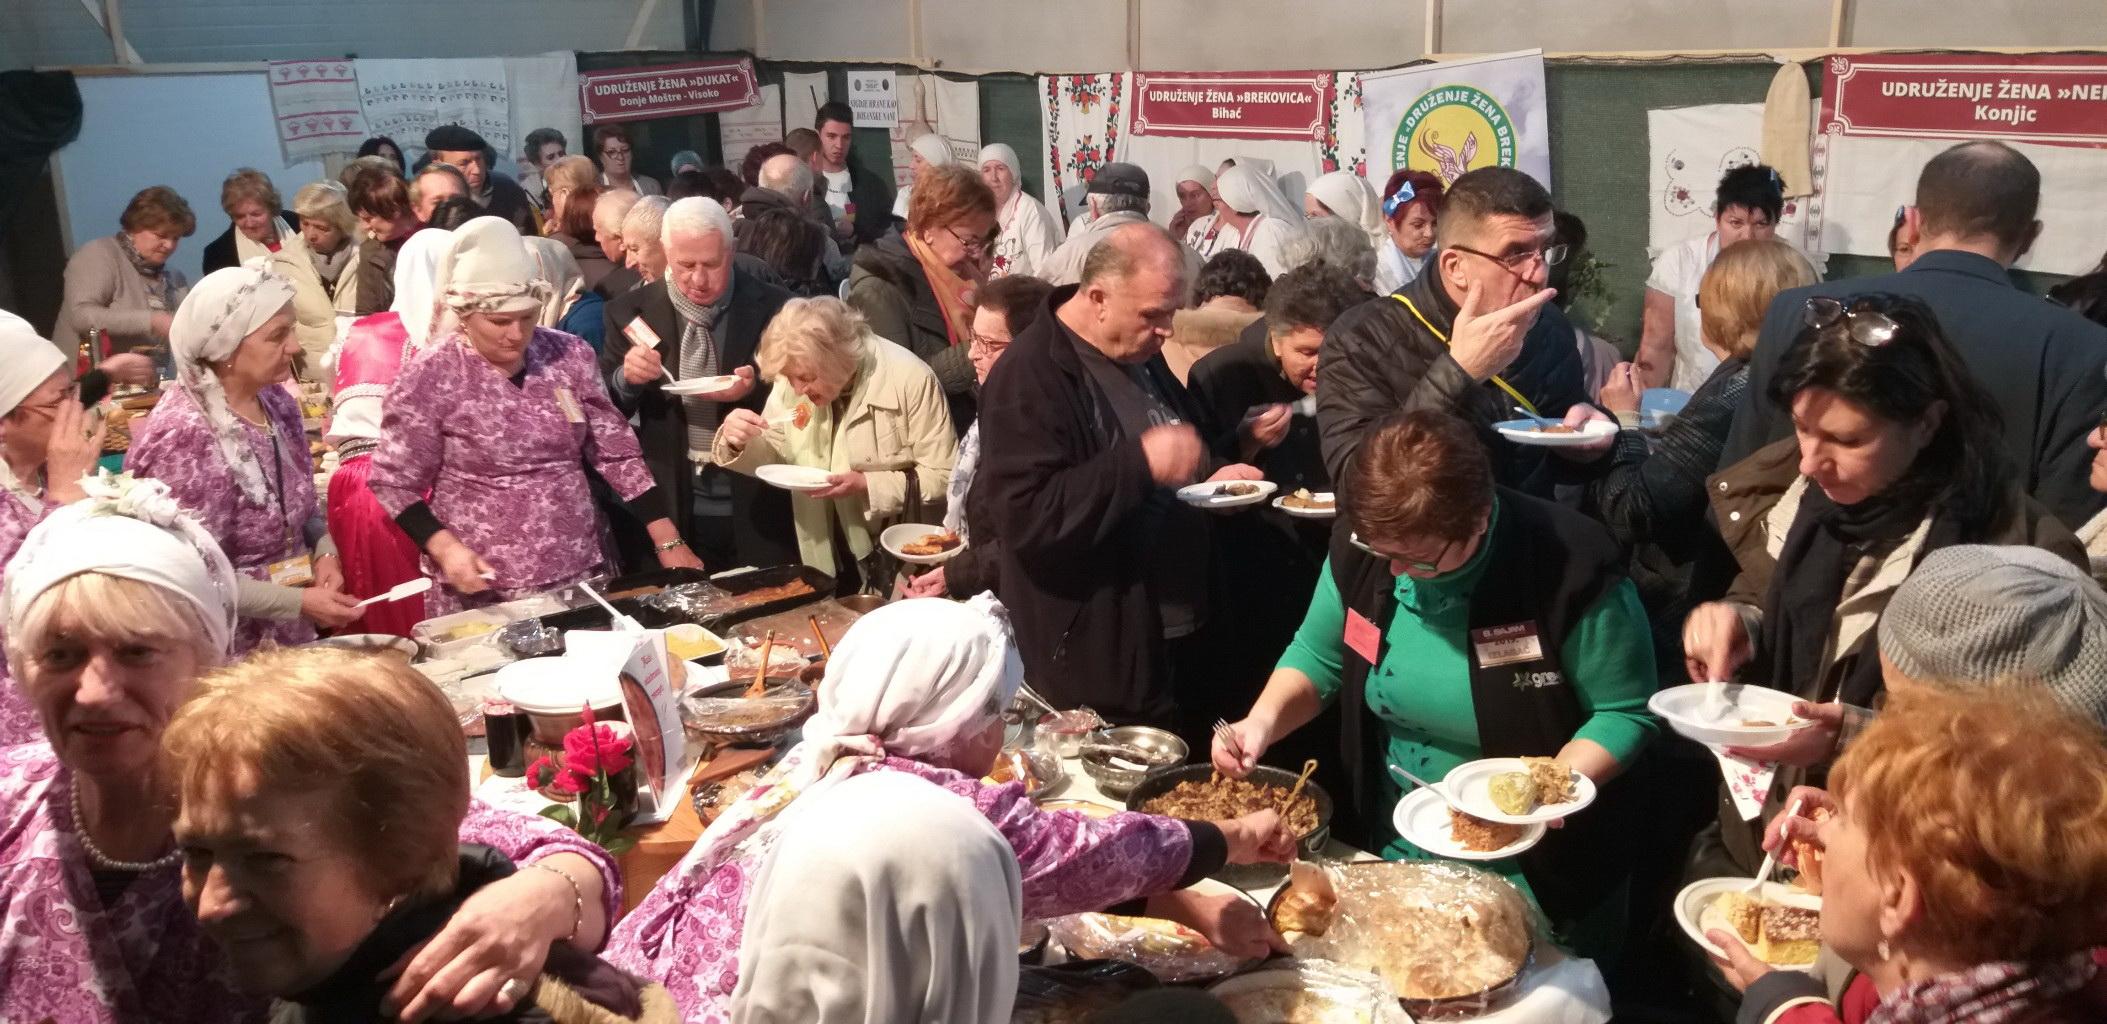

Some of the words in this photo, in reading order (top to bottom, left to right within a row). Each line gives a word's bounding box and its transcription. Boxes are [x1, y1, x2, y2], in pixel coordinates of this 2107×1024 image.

[594, 78, 657, 96] UDRUŽENJE
[658, 77, 688, 91] ŽENA
[689, 73, 739, 88] »DUKAT«
[1881, 79, 1993, 101] UDRUŽENJE
[1997, 79, 2051, 99] ŽENA
[619, 96, 647, 108] Donje
[650, 93, 682, 104] Moštre
[688, 89, 719, 100] Visoko
[1149, 89, 1204, 106] UDRUŽENJE
[1205, 90, 1234, 104] ŽENA
[1236, 92, 1312, 104] »BREKOVICA«
[1212, 107, 1242, 119] Bihać
[1974, 105, 2037, 126] Konjic
[1471, 92, 1501, 125] ŽENA
[1497, 126, 1511, 167] BREK
